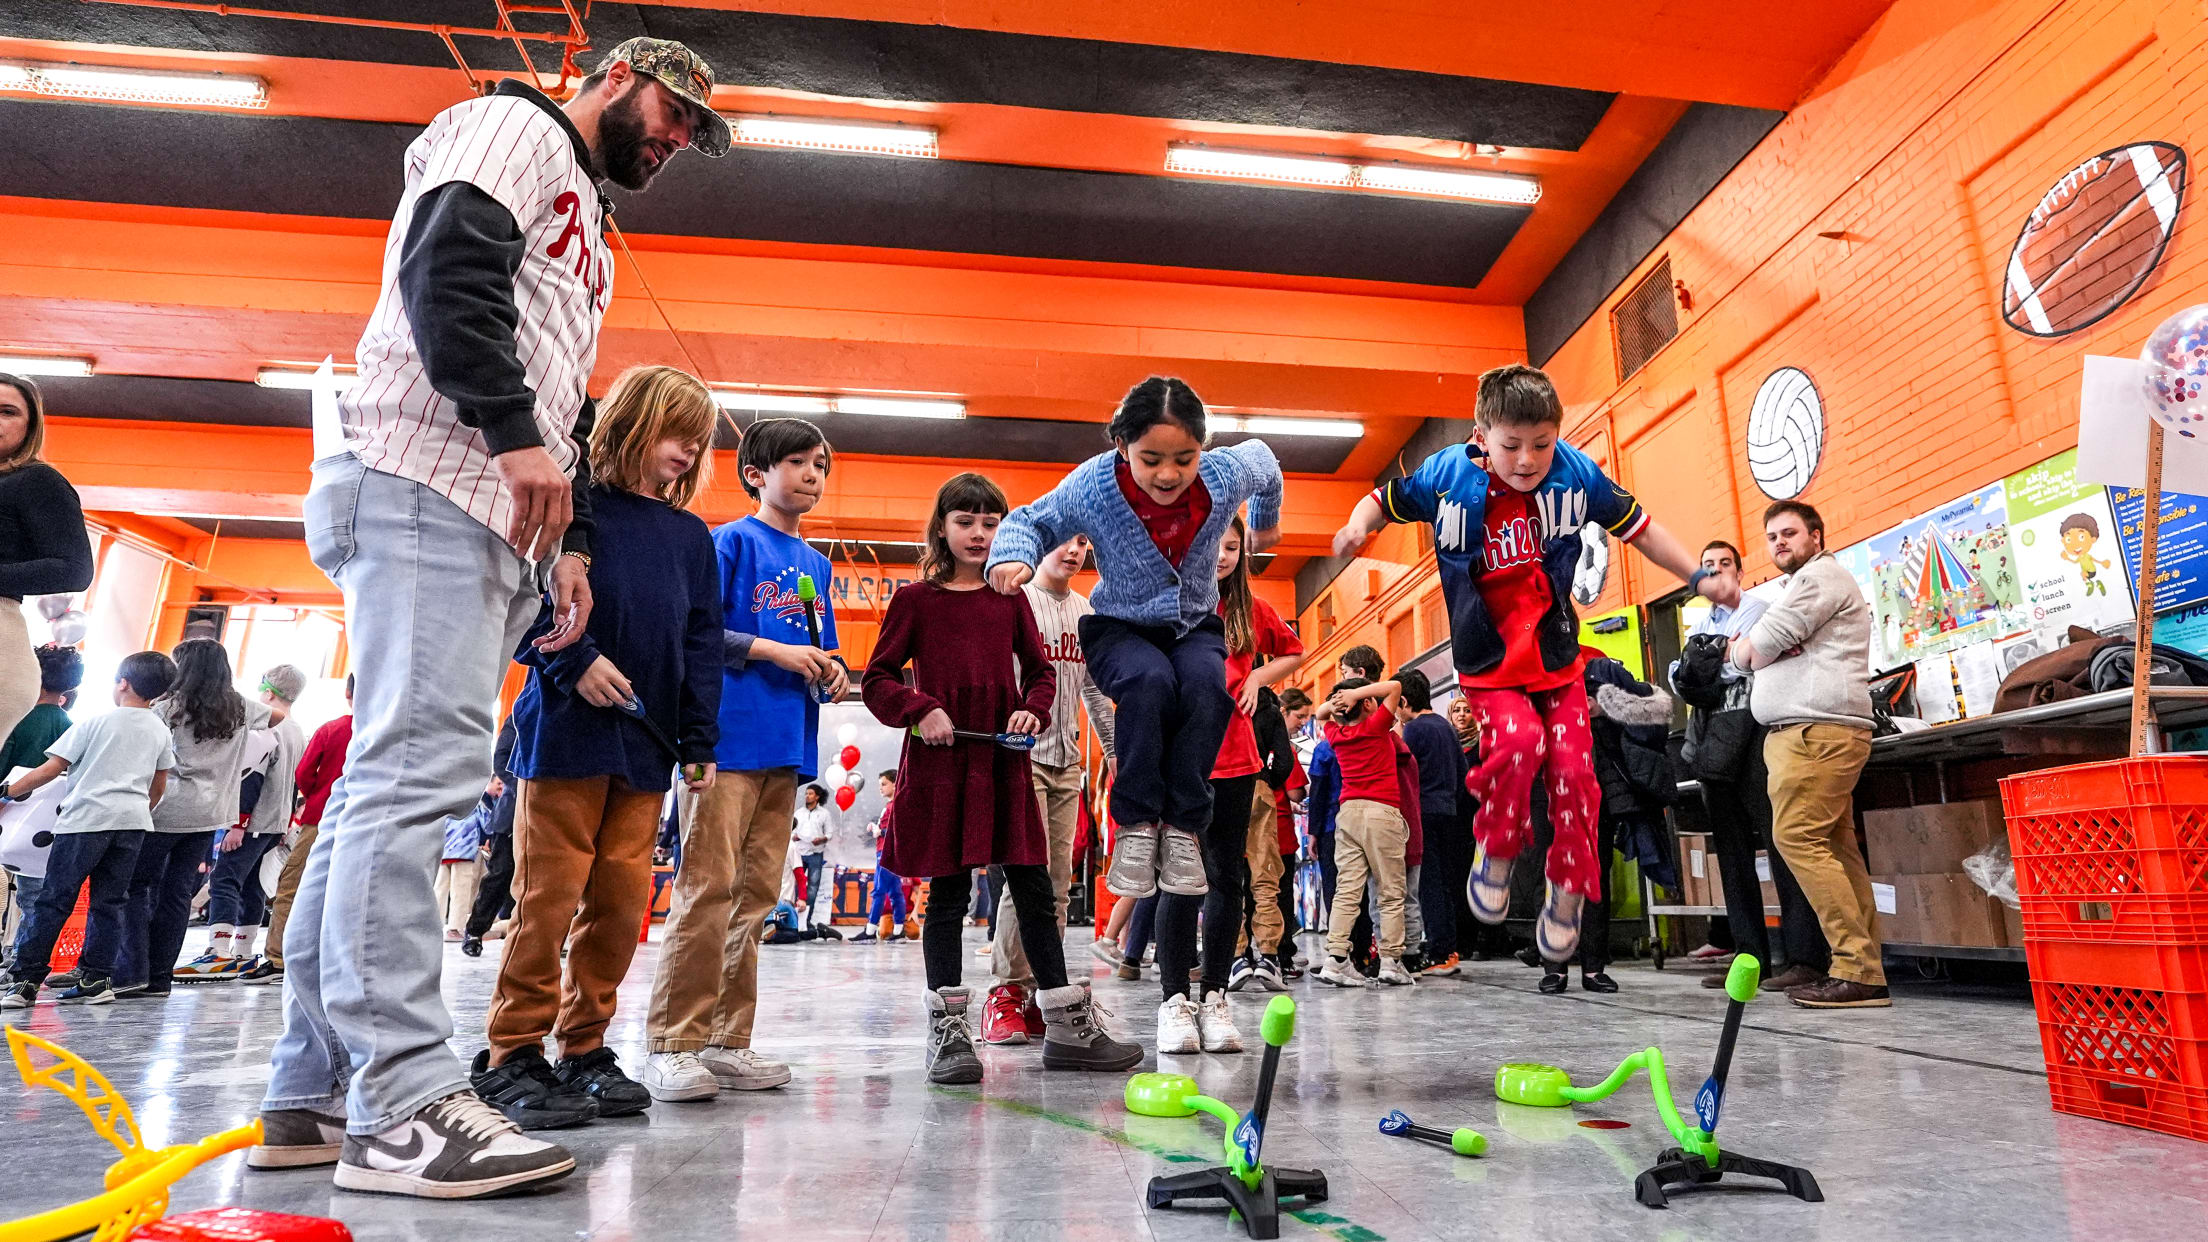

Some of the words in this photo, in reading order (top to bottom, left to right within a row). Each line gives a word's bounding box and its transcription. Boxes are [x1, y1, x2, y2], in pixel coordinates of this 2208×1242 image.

[2115, 492, 2127, 504] Be
[2123, 525, 2135, 537] Be
[2040, 574, 2065, 589] school
[2042, 589, 2065, 602] lunch
[2045, 603, 2072, 615] screen
